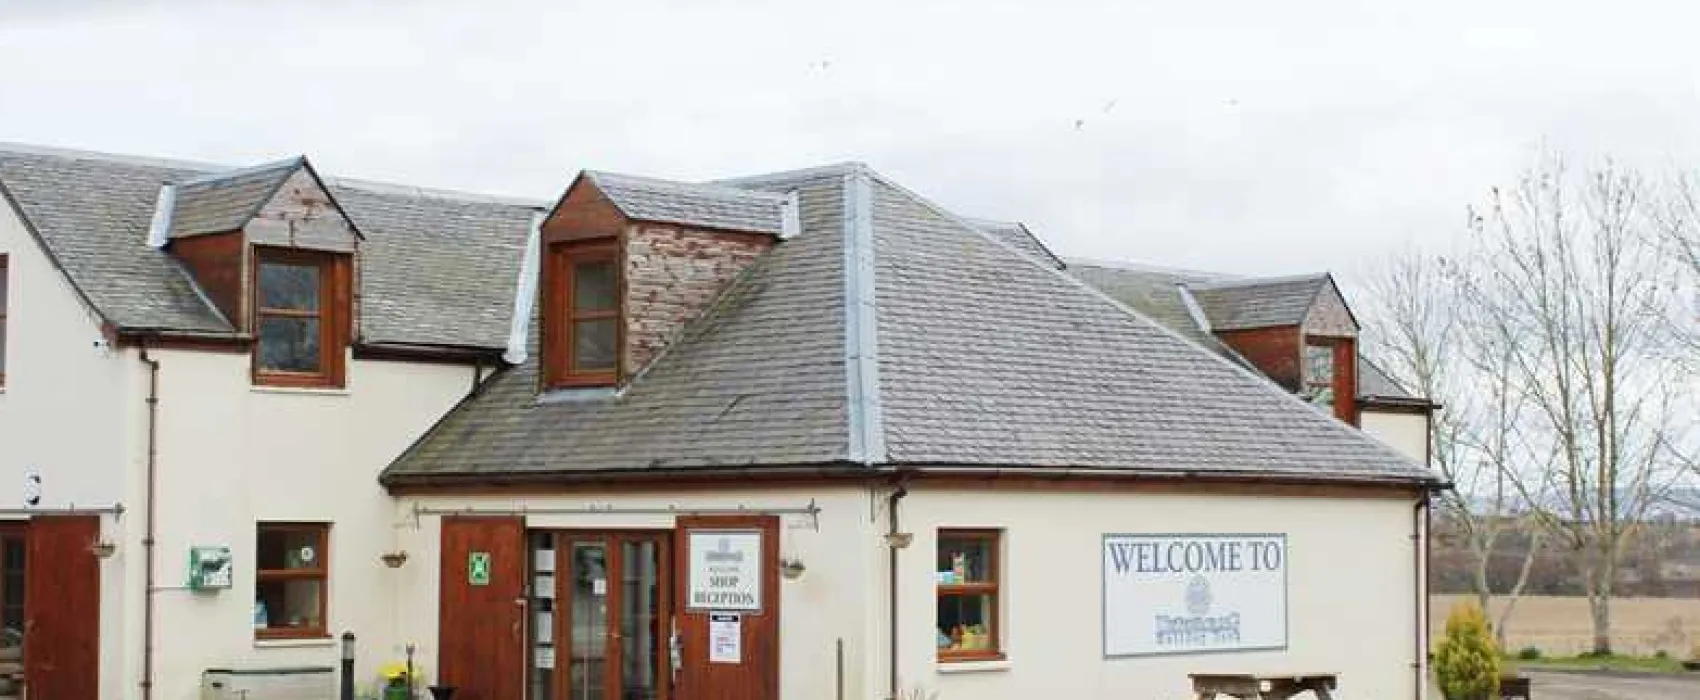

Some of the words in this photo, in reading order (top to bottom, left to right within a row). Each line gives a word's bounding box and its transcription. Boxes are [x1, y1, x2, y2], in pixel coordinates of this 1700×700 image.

[1109, 541, 1242, 574] WELCOME
[1247, 541, 1282, 572] TO
[709, 575, 739, 588] SHOP
[694, 592, 755, 604] RECEPTION
